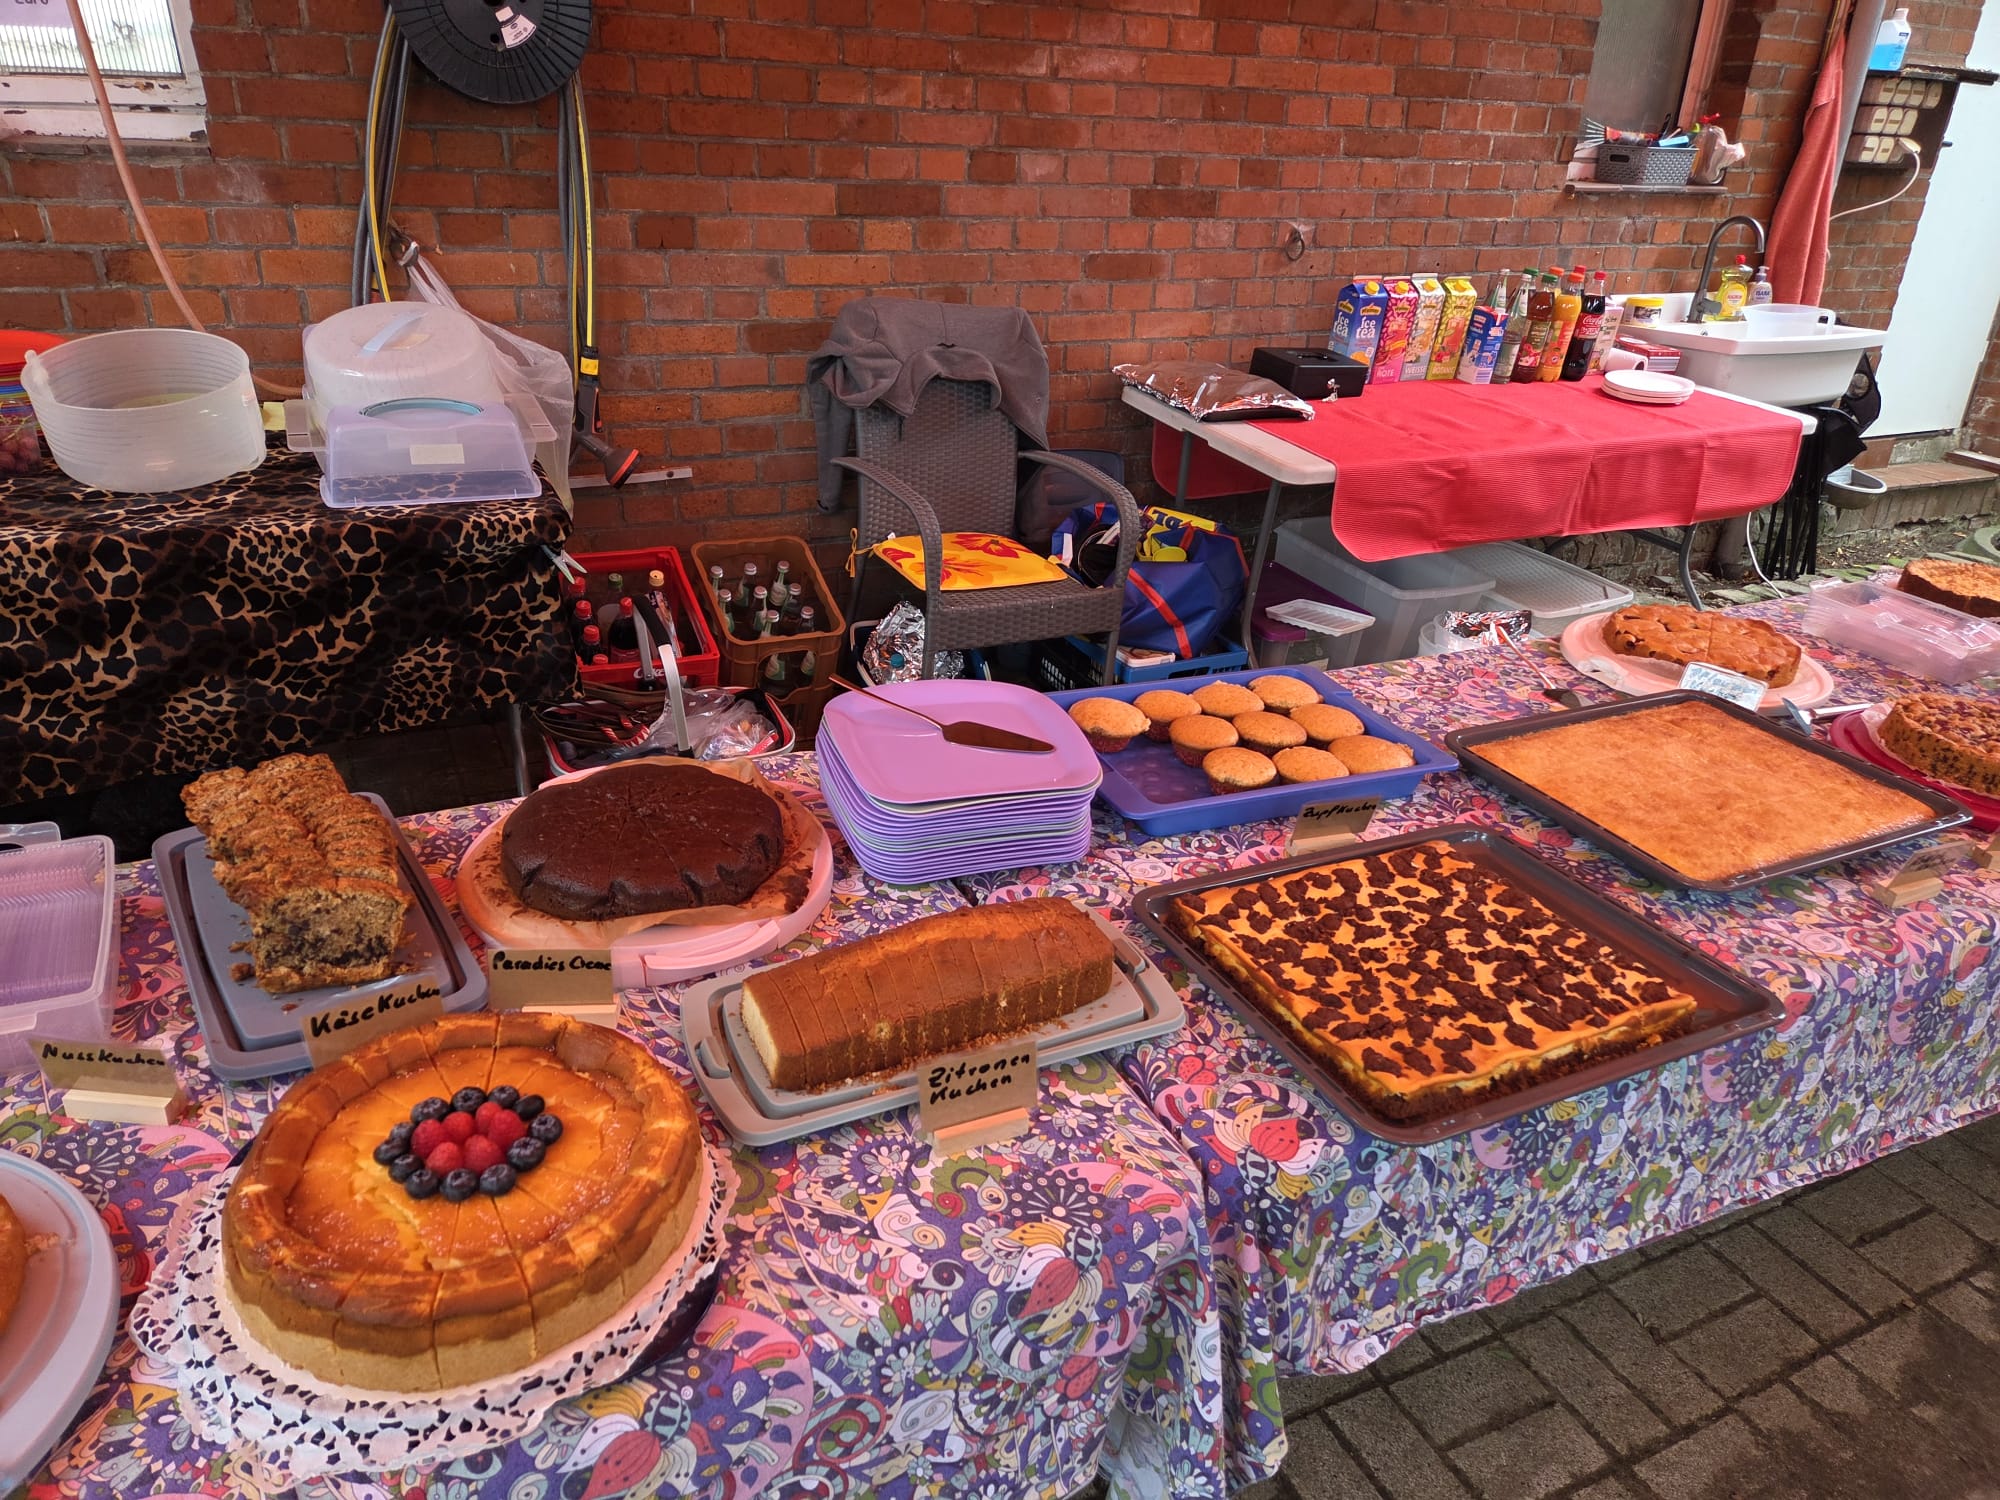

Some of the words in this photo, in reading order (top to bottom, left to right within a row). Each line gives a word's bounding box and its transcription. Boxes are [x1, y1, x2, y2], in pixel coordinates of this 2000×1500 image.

[493, 950, 565, 972] Paradies
[928, 1053, 1030, 1089] Zitronen
[930, 1074, 1012, 1105] Kuchen
